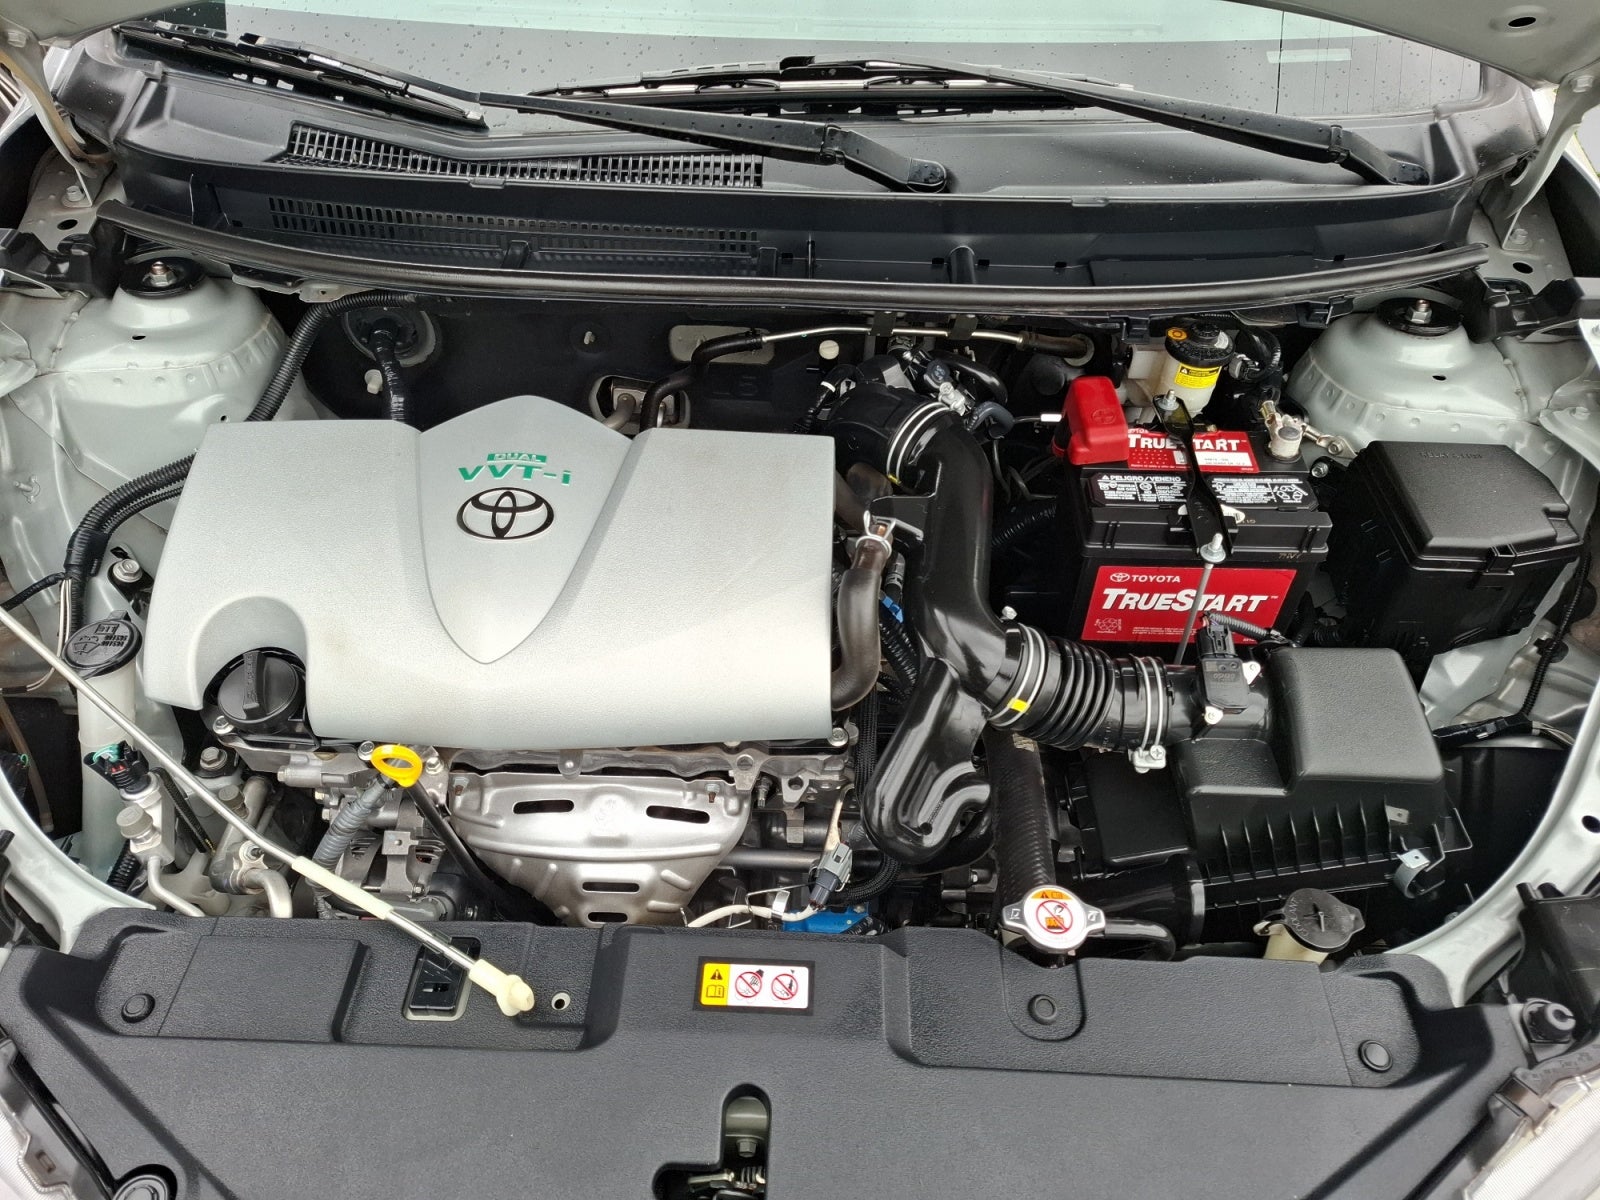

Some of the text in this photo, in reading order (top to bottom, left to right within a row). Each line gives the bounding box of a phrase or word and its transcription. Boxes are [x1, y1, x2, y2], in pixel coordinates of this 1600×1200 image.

[1128, 433, 1240, 451] TRUETART
[494, 453, 540, 462] DUAL
[458, 463, 572, 486] VVT-i
[1131, 574, 1181, 583] TOYOTA
[1102, 588, 1268, 612] TRUESTART
